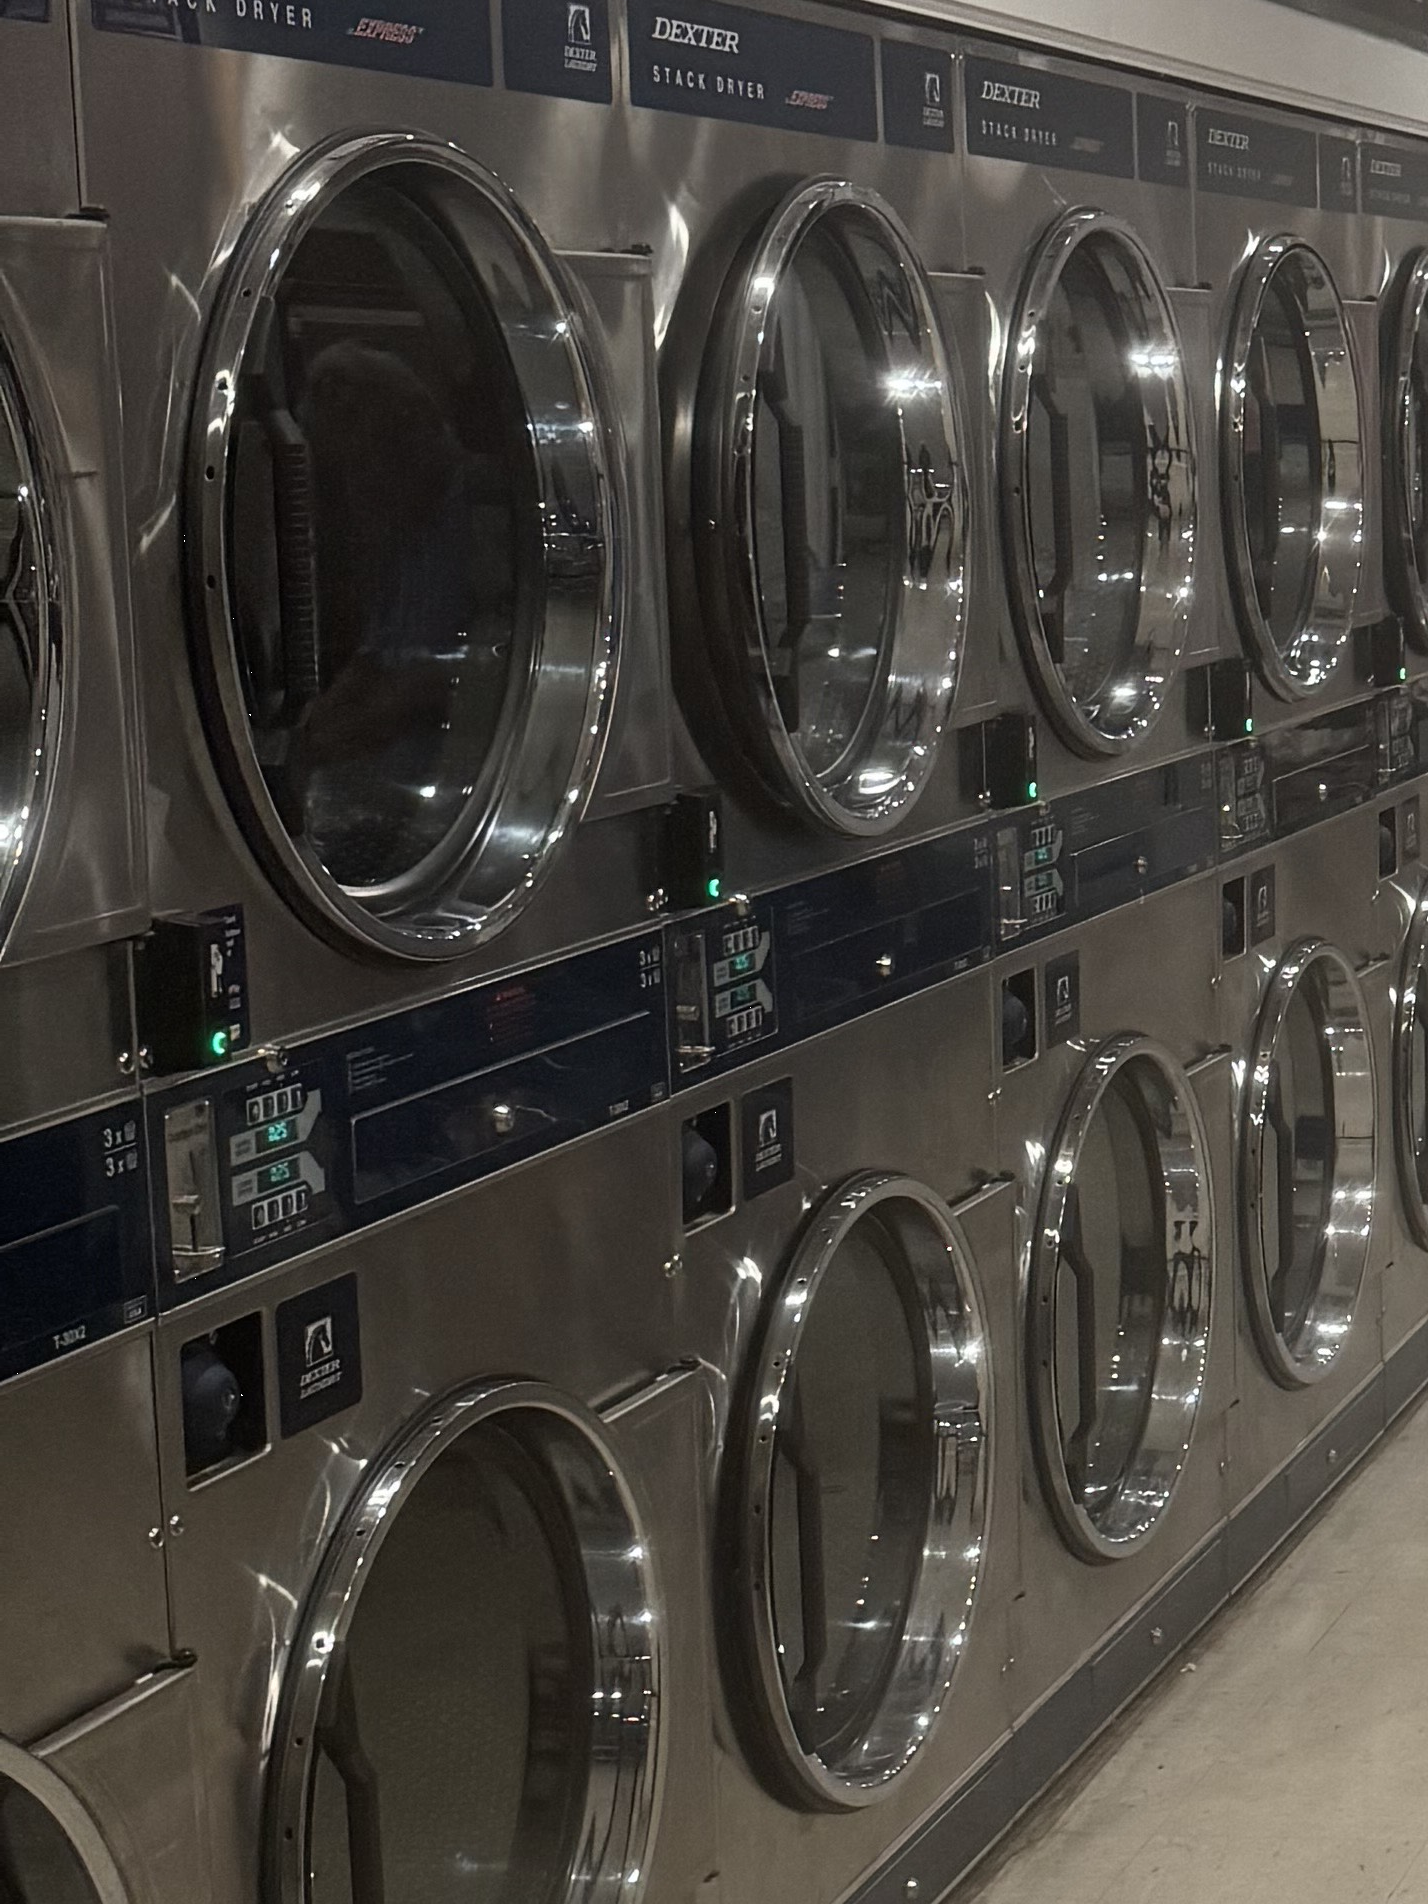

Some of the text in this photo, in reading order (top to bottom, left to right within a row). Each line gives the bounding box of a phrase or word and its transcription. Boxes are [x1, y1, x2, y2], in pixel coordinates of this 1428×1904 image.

[350, 16, 422, 45] EXPRESS
[651, 16, 740, 54] DEXTER
[653, 64, 765, 100] STACK DRYER
[980, 80, 1041, 109] DEXTER
[103, 1128, 114, 1148] 3
[105, 1157, 116, 1178] 3
